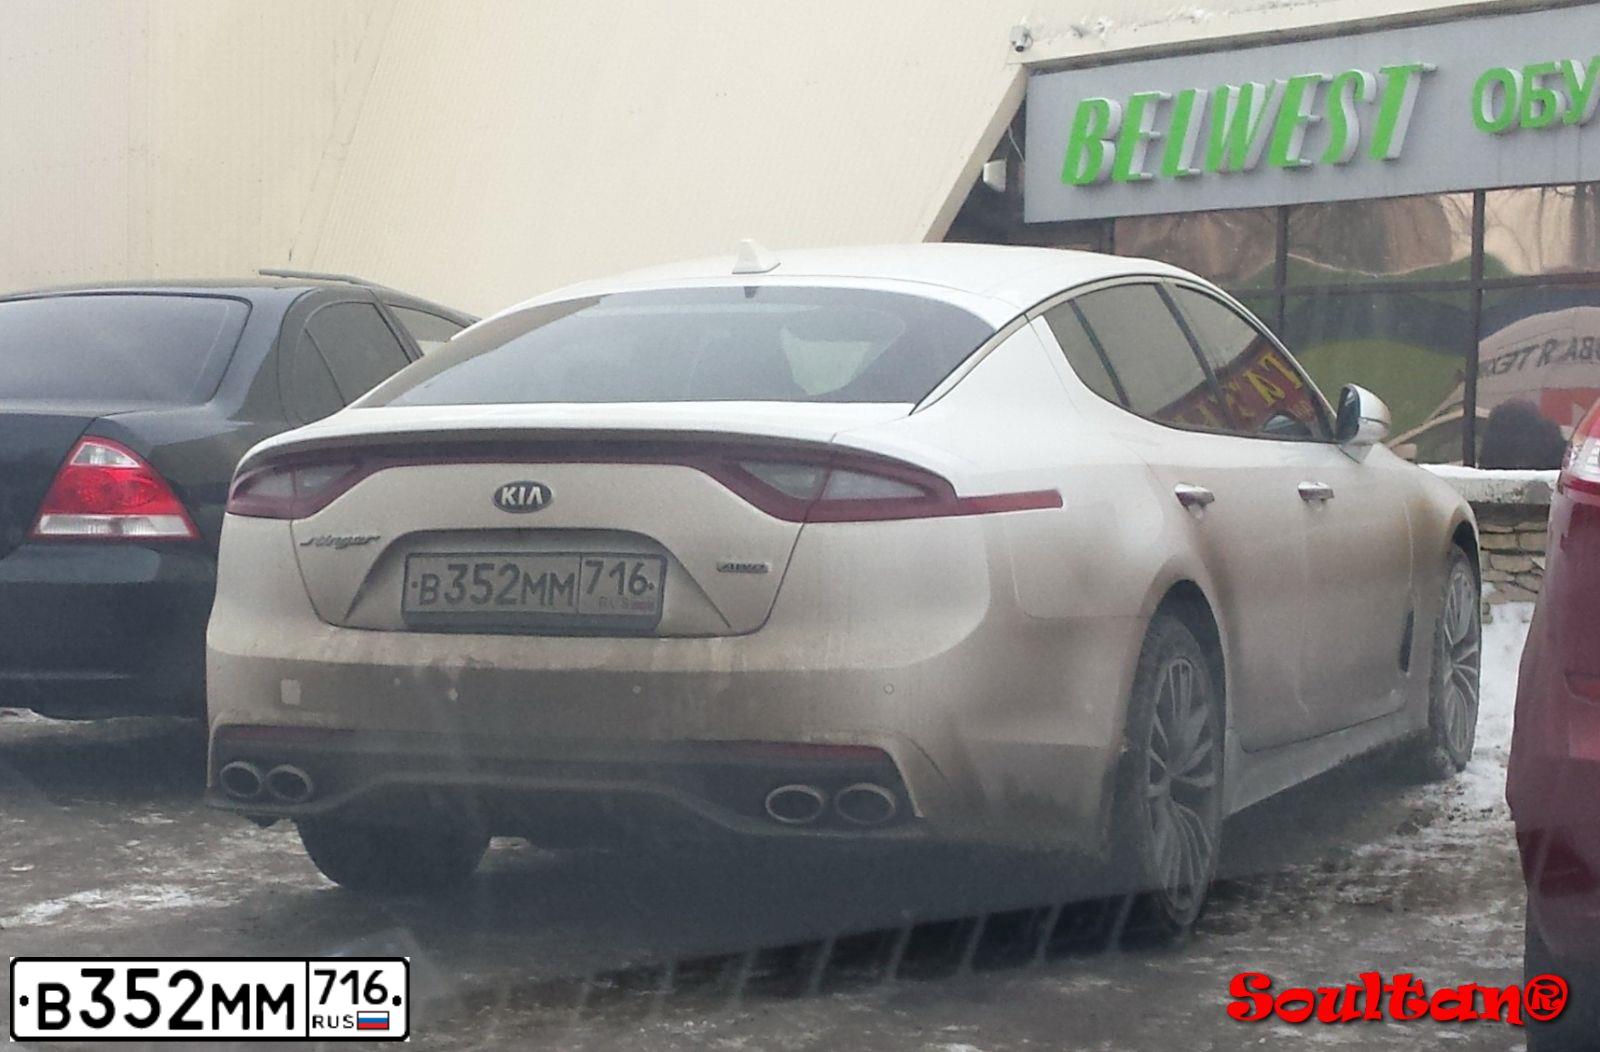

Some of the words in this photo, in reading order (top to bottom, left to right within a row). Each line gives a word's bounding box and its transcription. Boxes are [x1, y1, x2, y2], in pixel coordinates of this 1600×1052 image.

[1061, 62, 1438, 186] BELWEST
[499, 485, 546, 507] KIA
[584, 560, 650, 596] 716
